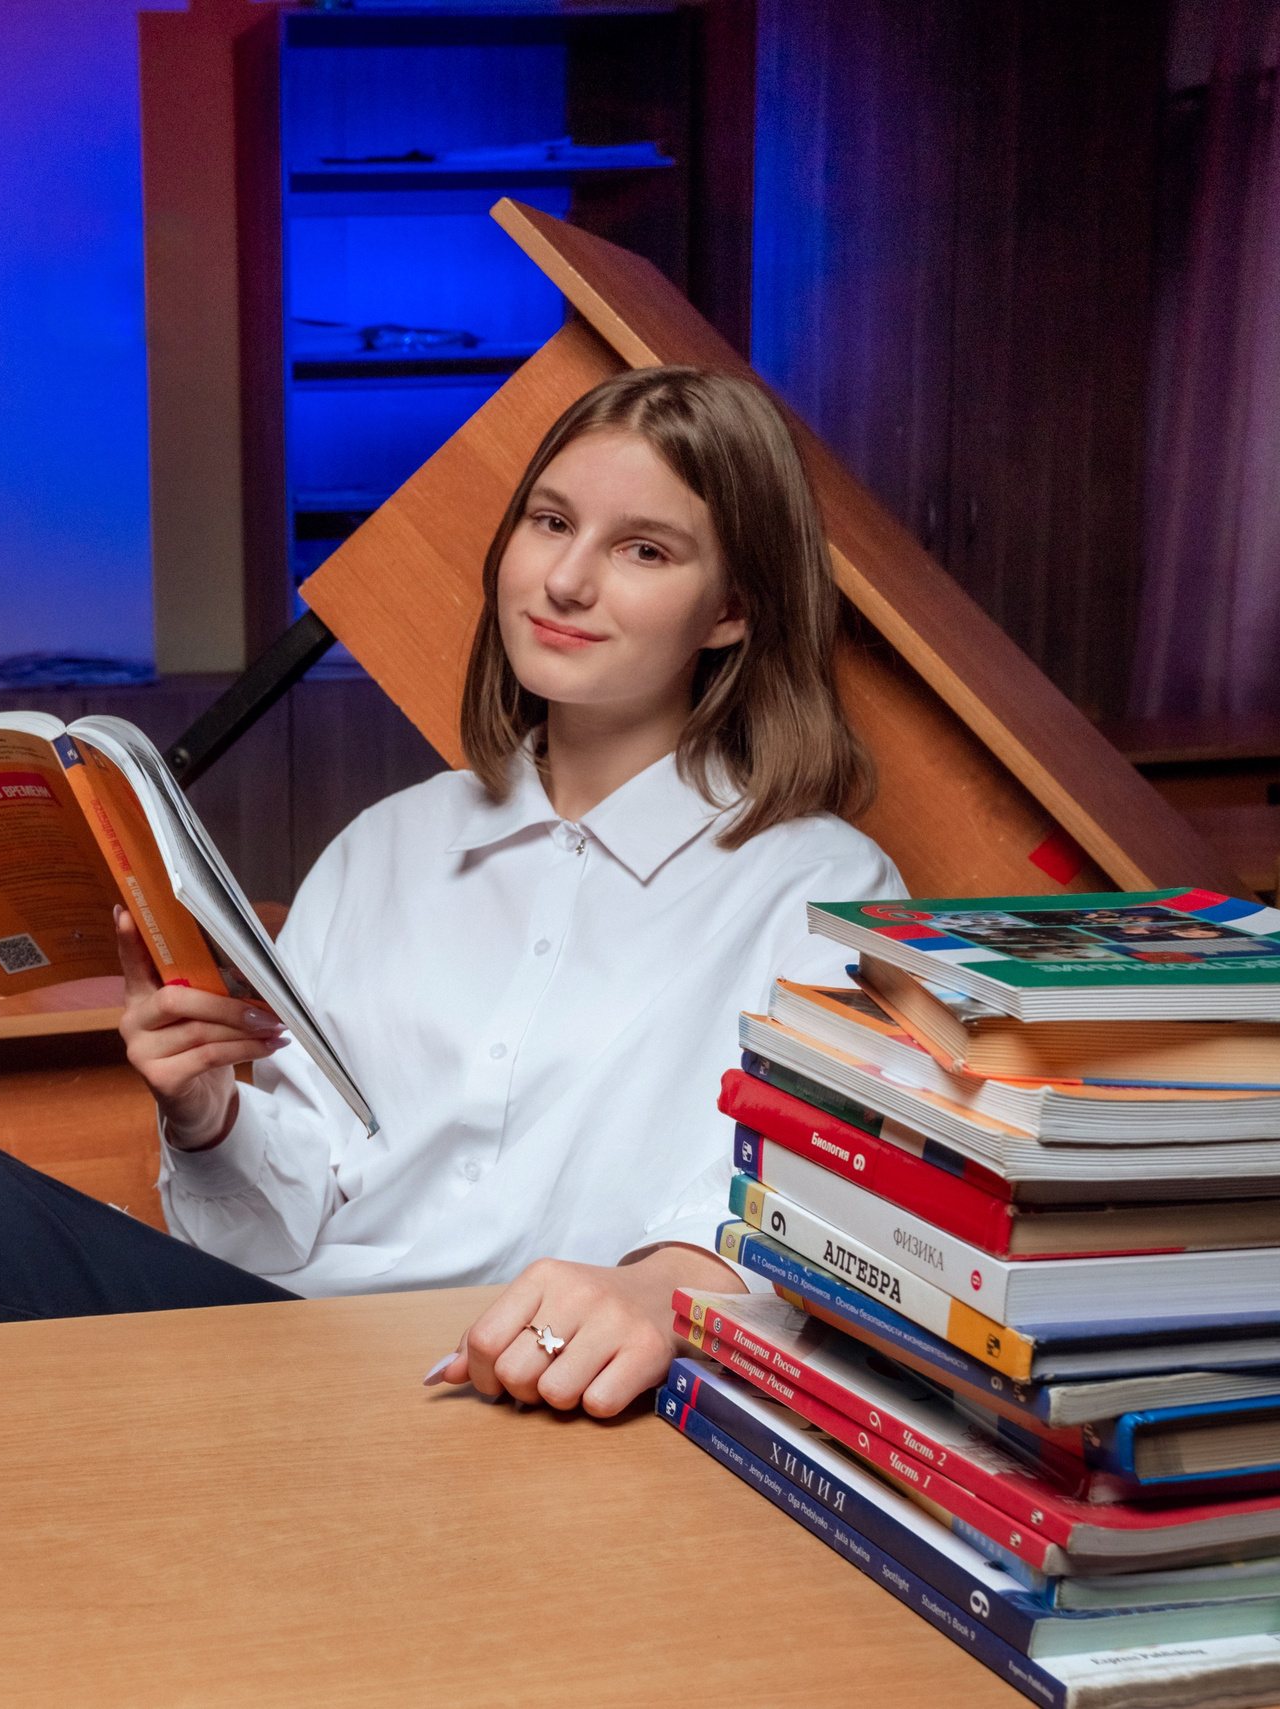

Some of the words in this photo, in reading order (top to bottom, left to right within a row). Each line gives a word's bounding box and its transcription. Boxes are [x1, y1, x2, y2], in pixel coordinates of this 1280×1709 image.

[1, 785, 52, 799] ВРЕМЕНИ
[126, 875, 147, 908] ИСТОРИЯ
[811, 1131, 850, 1162] Биология
[853, 1153, 866, 1171] 9
[771, 1210, 787, 1236] 9
[823, 1239, 902, 1305] АЛГЕБРА
[893, 1227, 945, 1272] ФИЗИКА
[760, 1257, 787, 1279] Смирнов
[835, 1296, 859, 1316] Основы
[859, 1307, 903, 1337] безопасности
[903, 1331, 969, 1371] жизнедеятельности
[990, 1375, 1003, 1391] 9
[729, 1350, 765, 1381] История
[766, 1372, 795, 1400] России
[858, 1431, 870, 1454] 9
[889, 1451, 920, 1483] Часть
[922, 1475, 931, 1490] 1
[733, 1328, 770, 1361] История
[772, 1352, 801, 1380] России
[869, 1410, 882, 1433] 9
[902, 1429, 935, 1461] Часть
[937, 1452, 948, 1467] 2
[711, 1433, 730, 1455] Virginia
[729, 1448, 744, 1466] Evans
[748, 1463, 764, 1482] Jenny
[763, 1473, 782, 1496] Dooley
[787, 1492, 801, 1511] Olga
[800, 1502, 829, 1530] Podolyako
[834, 1528, 849, 1547] Julia
[849, 1538, 871, 1563] Vaulina
[881, 1564, 910, 1593] Spotlight
[921, 1593, 952, 1625] Student's
[952, 1617, 970, 1638] Book
[969, 1630, 976, 1641] 9
[770, 1441, 847, 1513] ХИМИЯ
[970, 1590, 990, 1619] 9
[1090, 1653, 1141, 1666] Express
